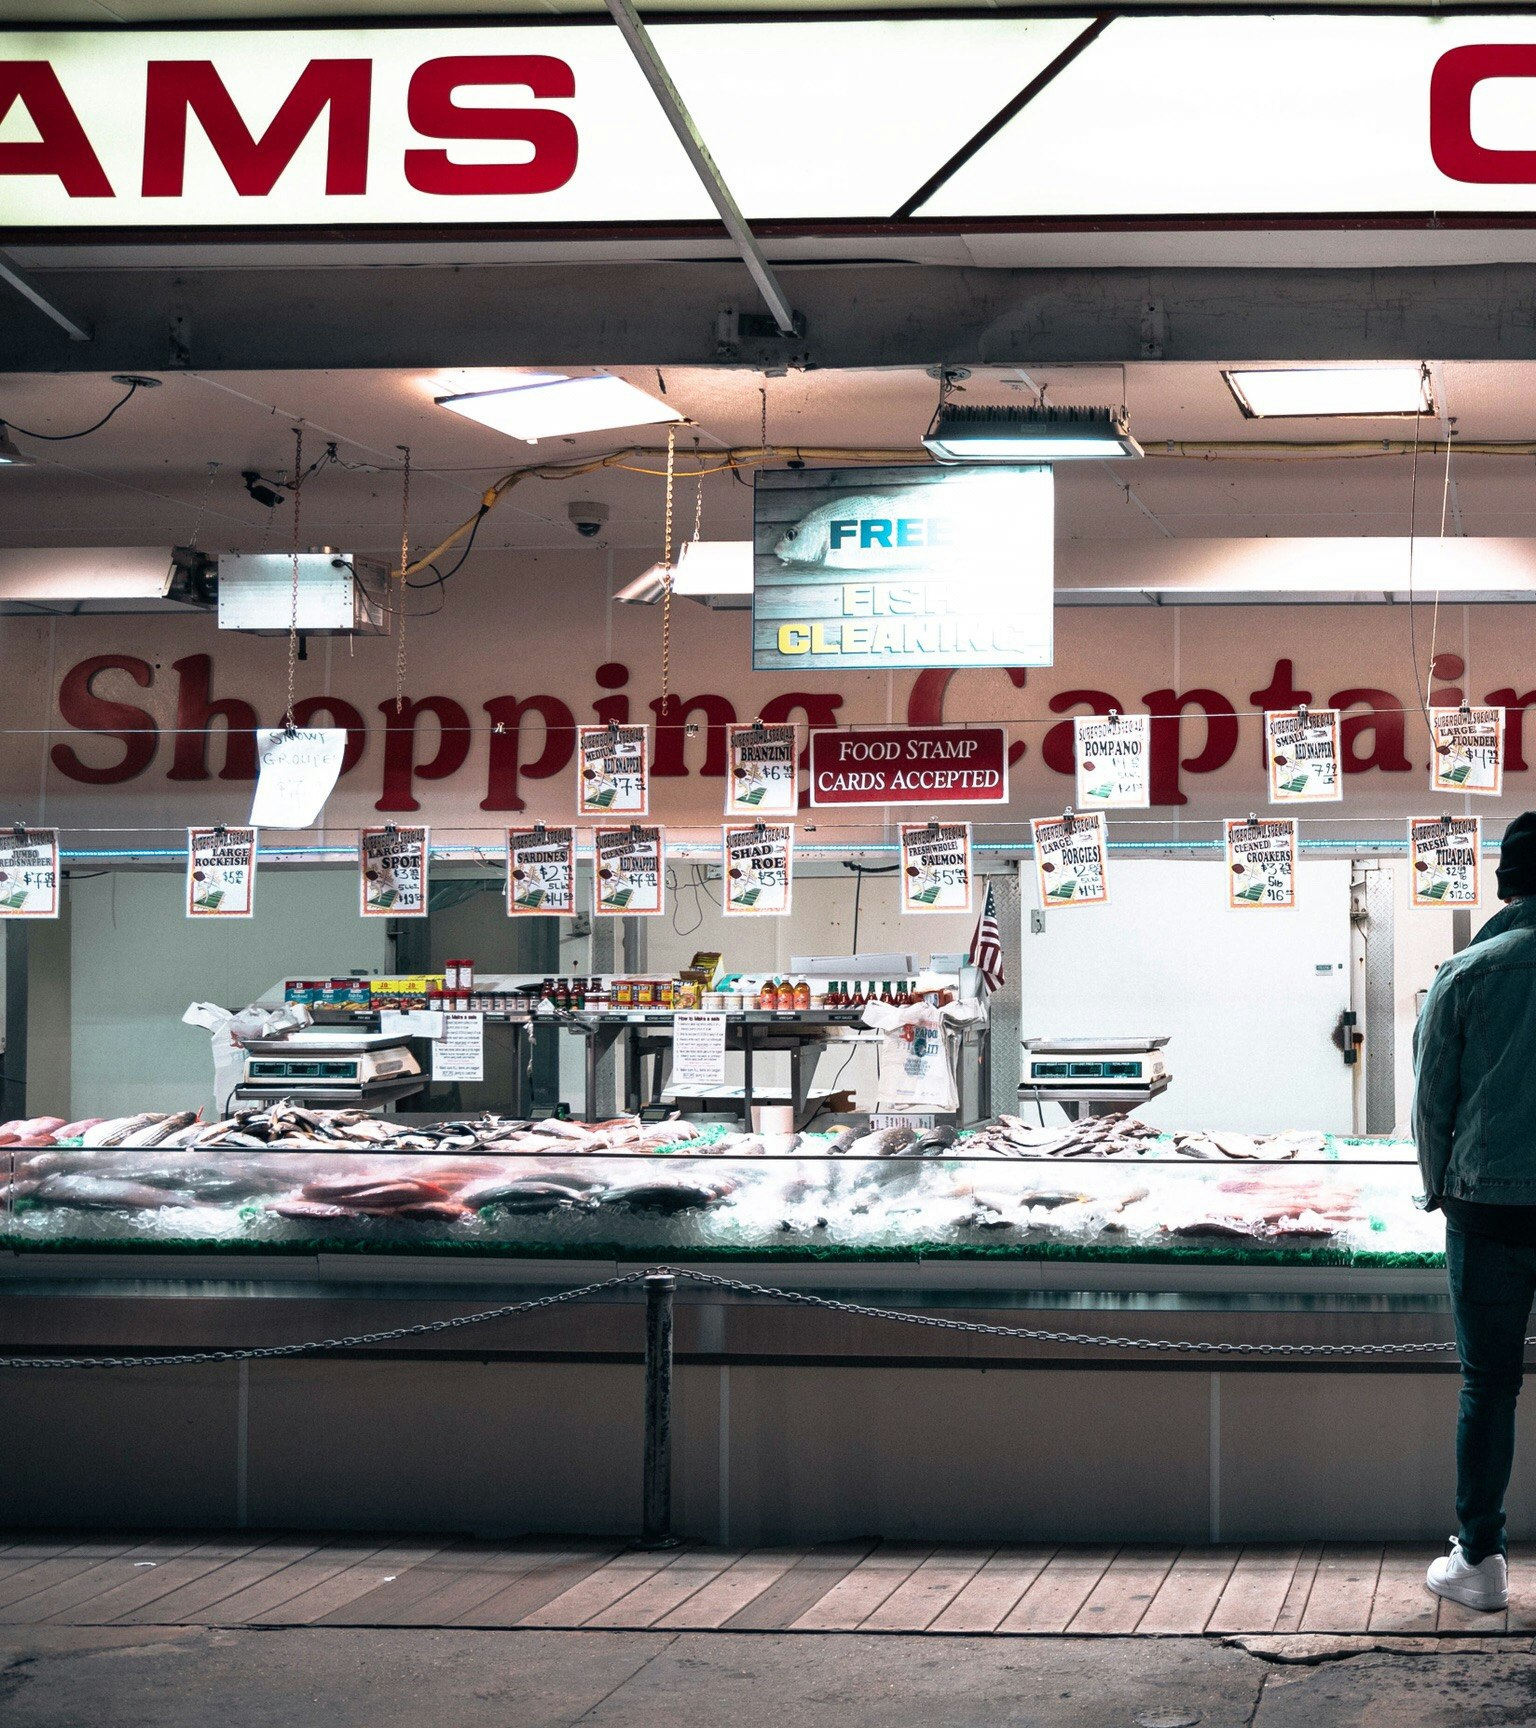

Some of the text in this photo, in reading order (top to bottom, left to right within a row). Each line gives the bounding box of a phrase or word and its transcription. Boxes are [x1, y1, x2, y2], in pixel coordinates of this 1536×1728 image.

[0, 54, 579, 198] AMS
[829, 518, 953, 549] FREE
[777, 621, 1026, 656] CLEANING
[270, 731, 327, 745] SNOWY
[1440, 726, 1475, 737] LARGE
[1276, 732, 1306, 748] SMALL
[1452, 736, 1496, 747] FLOUNDER
[585, 746, 617, 762] MEDIUM
[741, 747, 791, 761] BRANZINI
[839, 738, 978, 761] FOOD STAMP
[1085, 741, 1140, 756] POMPANO
[1307, 741, 1334, 759] SNAPPER
[263, 752, 336, 768] GROUPE
[818, 768, 999, 791] CARDS ACCEPTED
[11, 849, 40, 858] JUMBO
[212, 848, 249, 857] LARGE
[369, 844, 407, 859] LARGE
[601, 845, 636, 860] CLEANED
[731, 845, 773, 860] SHAD
[909, 842, 957, 857] FRESH WHOLE
[1042, 838, 1071, 854] LARGE
[1234, 840, 1269, 853] CLEANED
[1417, 839, 1447, 854] FRESH
[15, 858, 51, 867] SNAPPER
[195, 857, 249, 867] ROCKFISH
[381, 855, 420, 869] SPOT
[517, 851, 567, 863] SARDINES
[921, 854, 966, 866] SALMON
[1062, 845, 1100, 865] PORGIES
[1247, 850, 1292, 863] CROAKERS
[1436, 848, 1474, 866] TILAPIA
[751, 857, 785, 870] ROE
